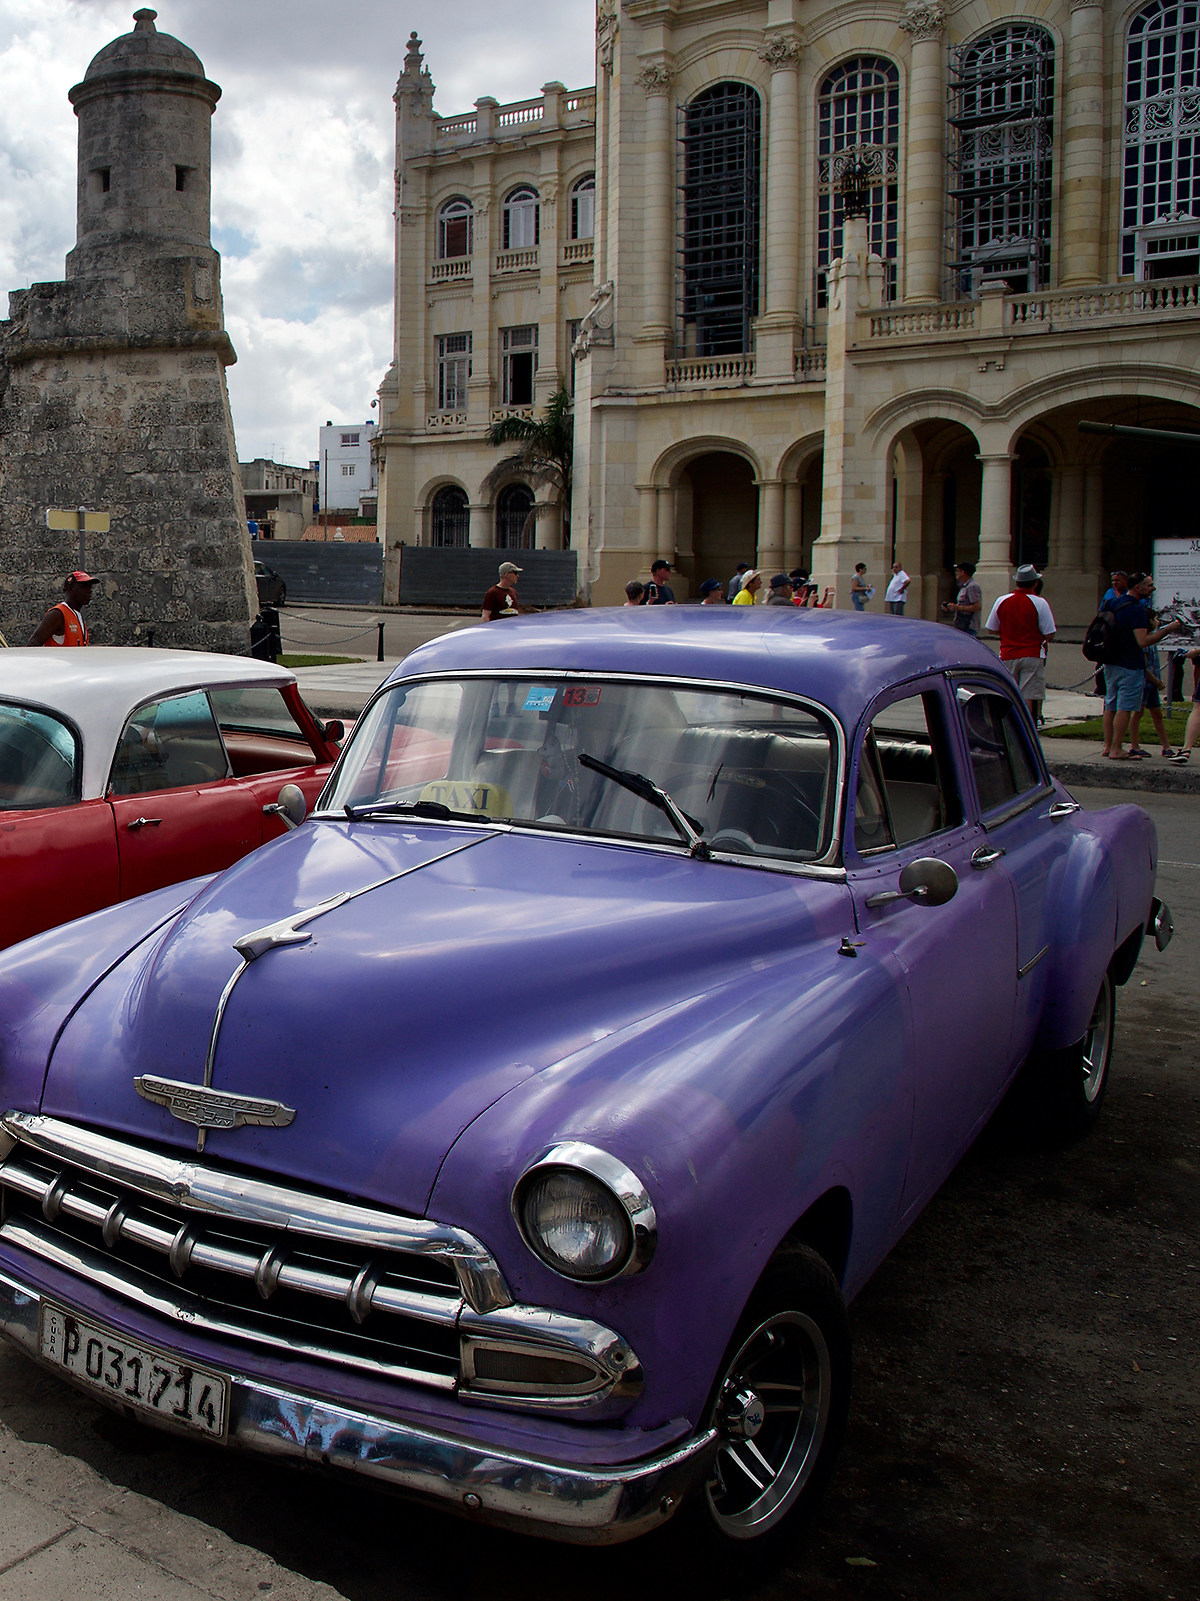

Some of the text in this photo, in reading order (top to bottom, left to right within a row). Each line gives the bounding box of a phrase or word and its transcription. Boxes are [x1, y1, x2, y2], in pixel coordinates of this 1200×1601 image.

[566, 688, 586, 705] 13
[430, 786, 490, 810] TAXI
[49, 1316, 57, 1355] CUBA
